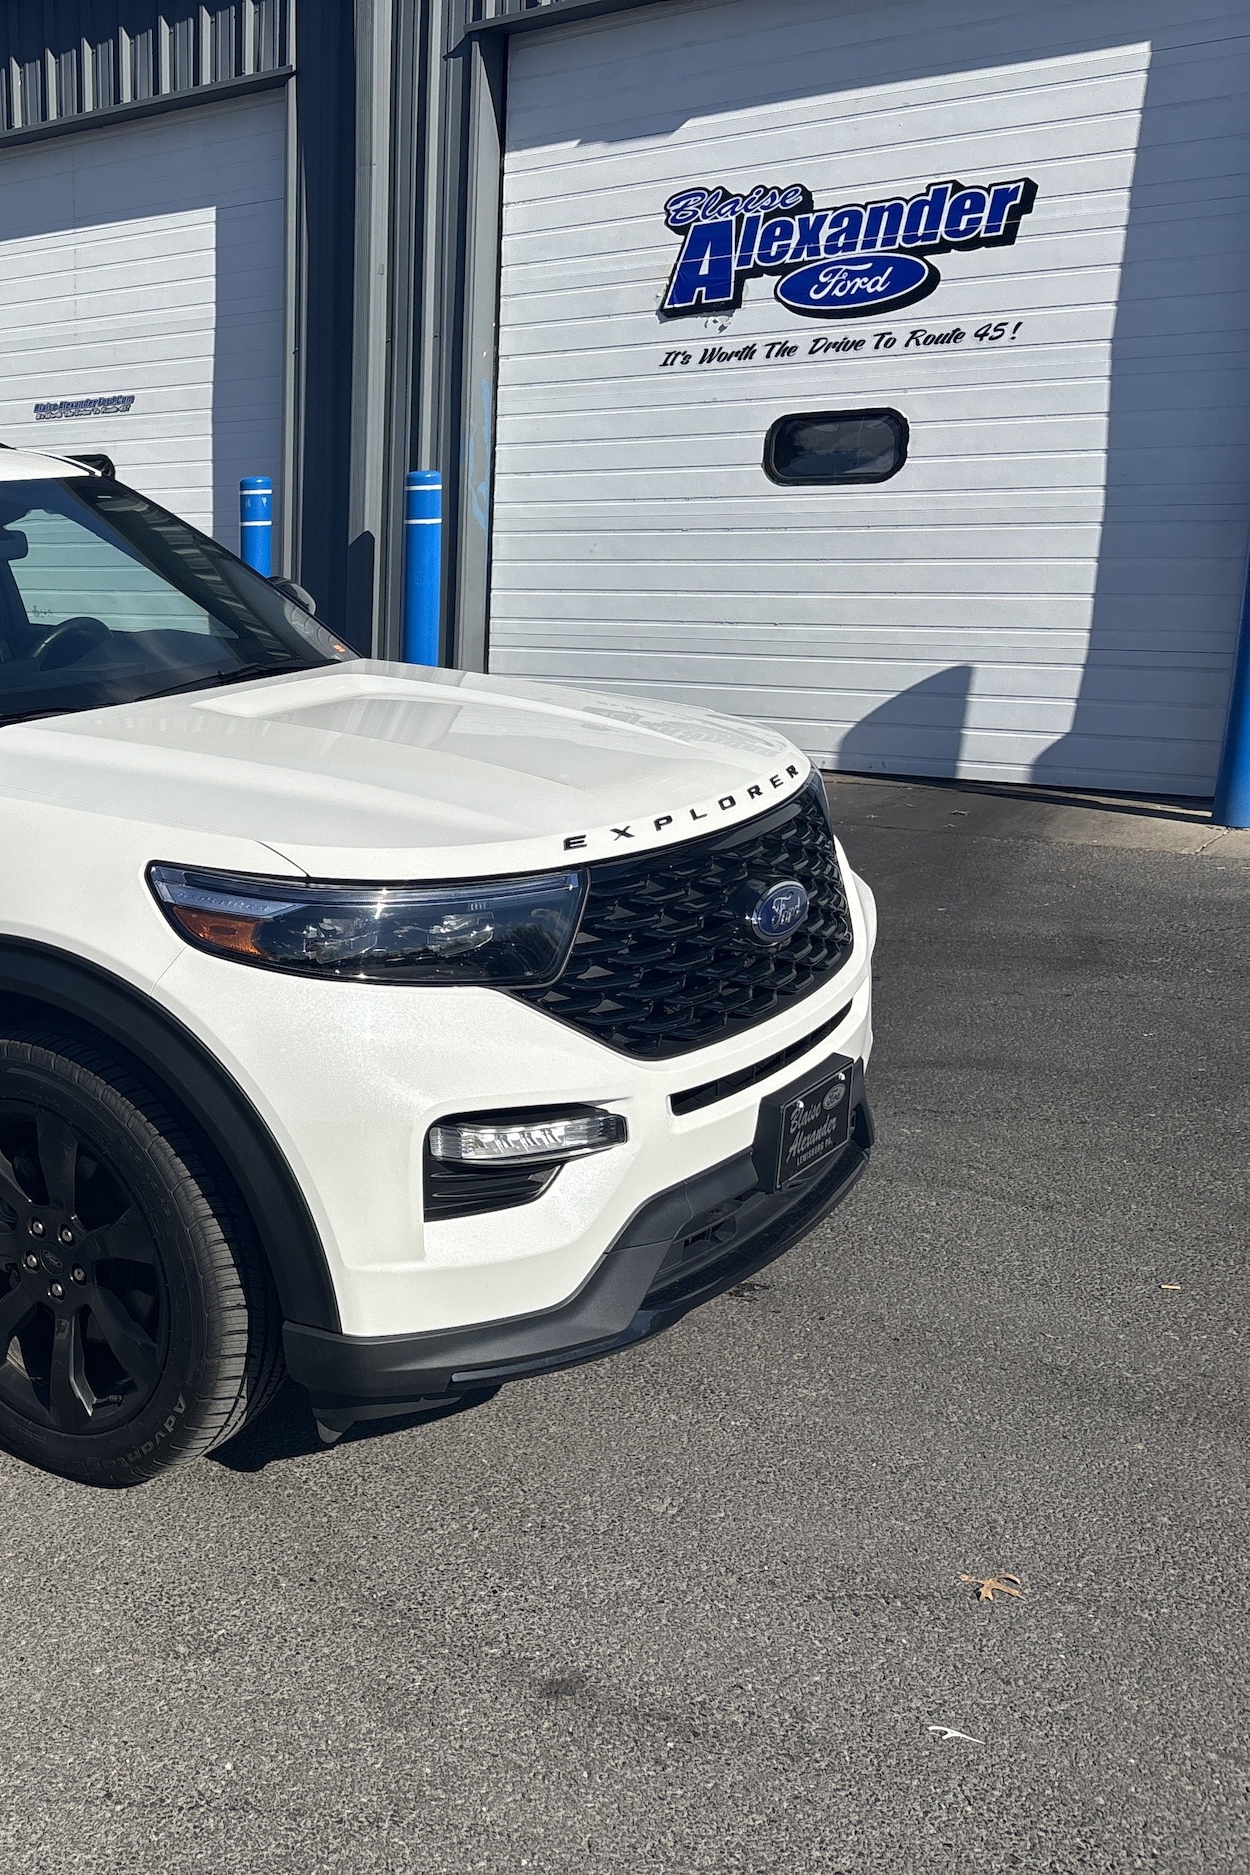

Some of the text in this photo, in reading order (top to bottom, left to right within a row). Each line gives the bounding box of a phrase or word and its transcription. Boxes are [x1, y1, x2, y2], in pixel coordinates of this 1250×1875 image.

[667, 184, 804, 227] Blaise
[662, 180, 1026, 309] Alexander
[809, 263, 891, 300] Ford
[659, 350, 691, 367] It's
[699, 343, 758, 365] Worth
[764, 340, 797, 360] The
[809, 335, 864, 355] Drive
[871, 331, 898, 350] To
[904, 326, 967, 347] Route
[562, 764, 799, 851] EXPLORER
[785, 1114, 837, 1163] Alexander
[789, 1102, 822, 1134] Blaise
[796, 1141, 825, 1167] LEWISBURG
